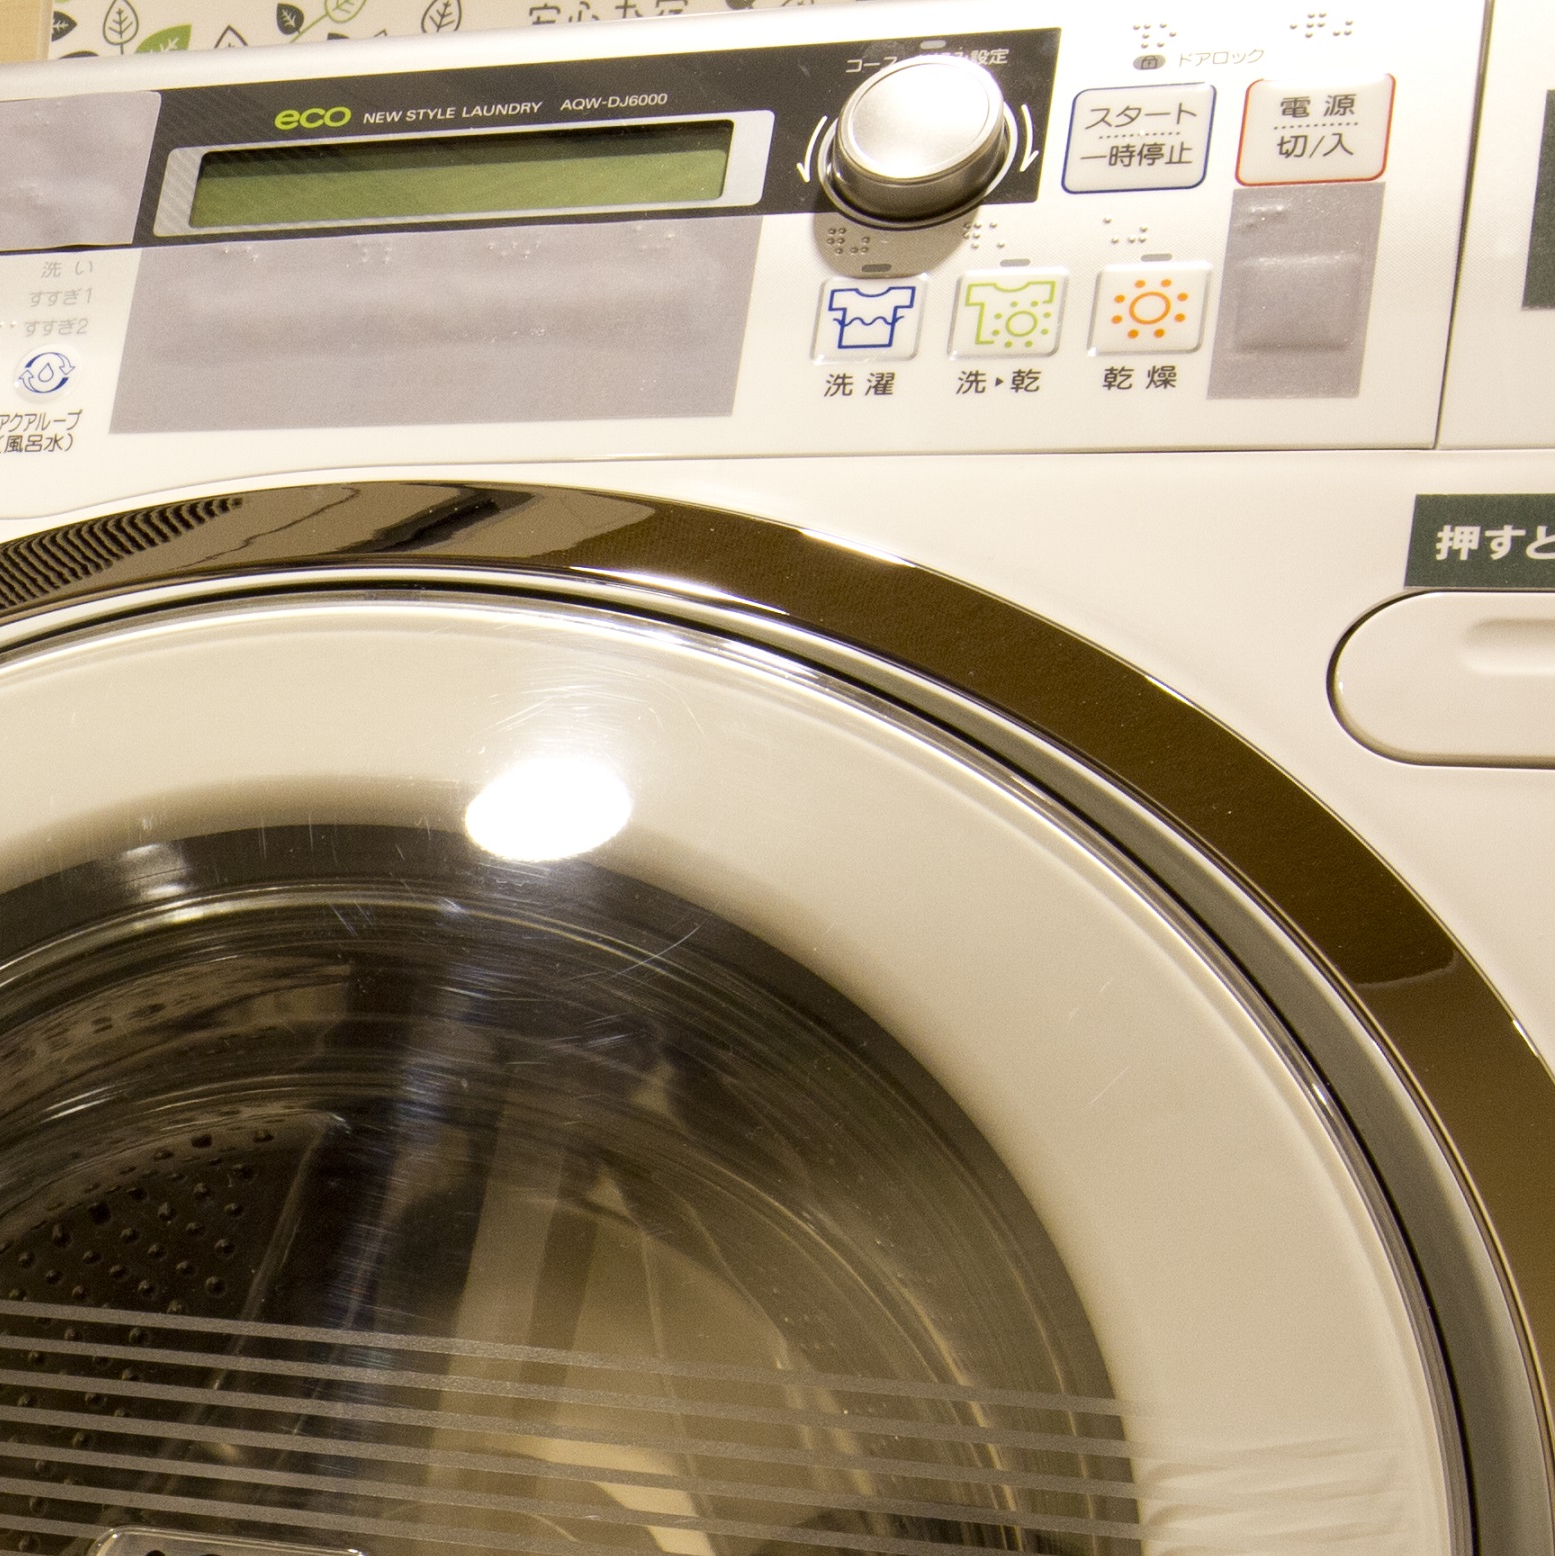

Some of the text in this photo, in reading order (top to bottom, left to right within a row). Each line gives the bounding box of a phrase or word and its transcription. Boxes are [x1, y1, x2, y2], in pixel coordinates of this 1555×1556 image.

[1175, 48, 1266, 68] ドアロック
[274, 92, 669, 131] eco NEW STYLE LAUNDRY AQW-DJ6000
[1083, 102, 1199, 132] スタート
[1279, 93, 1357, 119] 電源
[1078, 141, 1196, 169] 一時停止
[1276, 132, 1356, 161] 切/入
[40, 261, 95, 279] 洗い
[29, 287, 94, 307] すすぎ1
[23, 317, 90, 338] すすぎ2
[823, 371, 897, 398] 洗濯
[1102, 364, 1178, 391] 乾燥
[1435, 523, 1555, 562] 押すと
